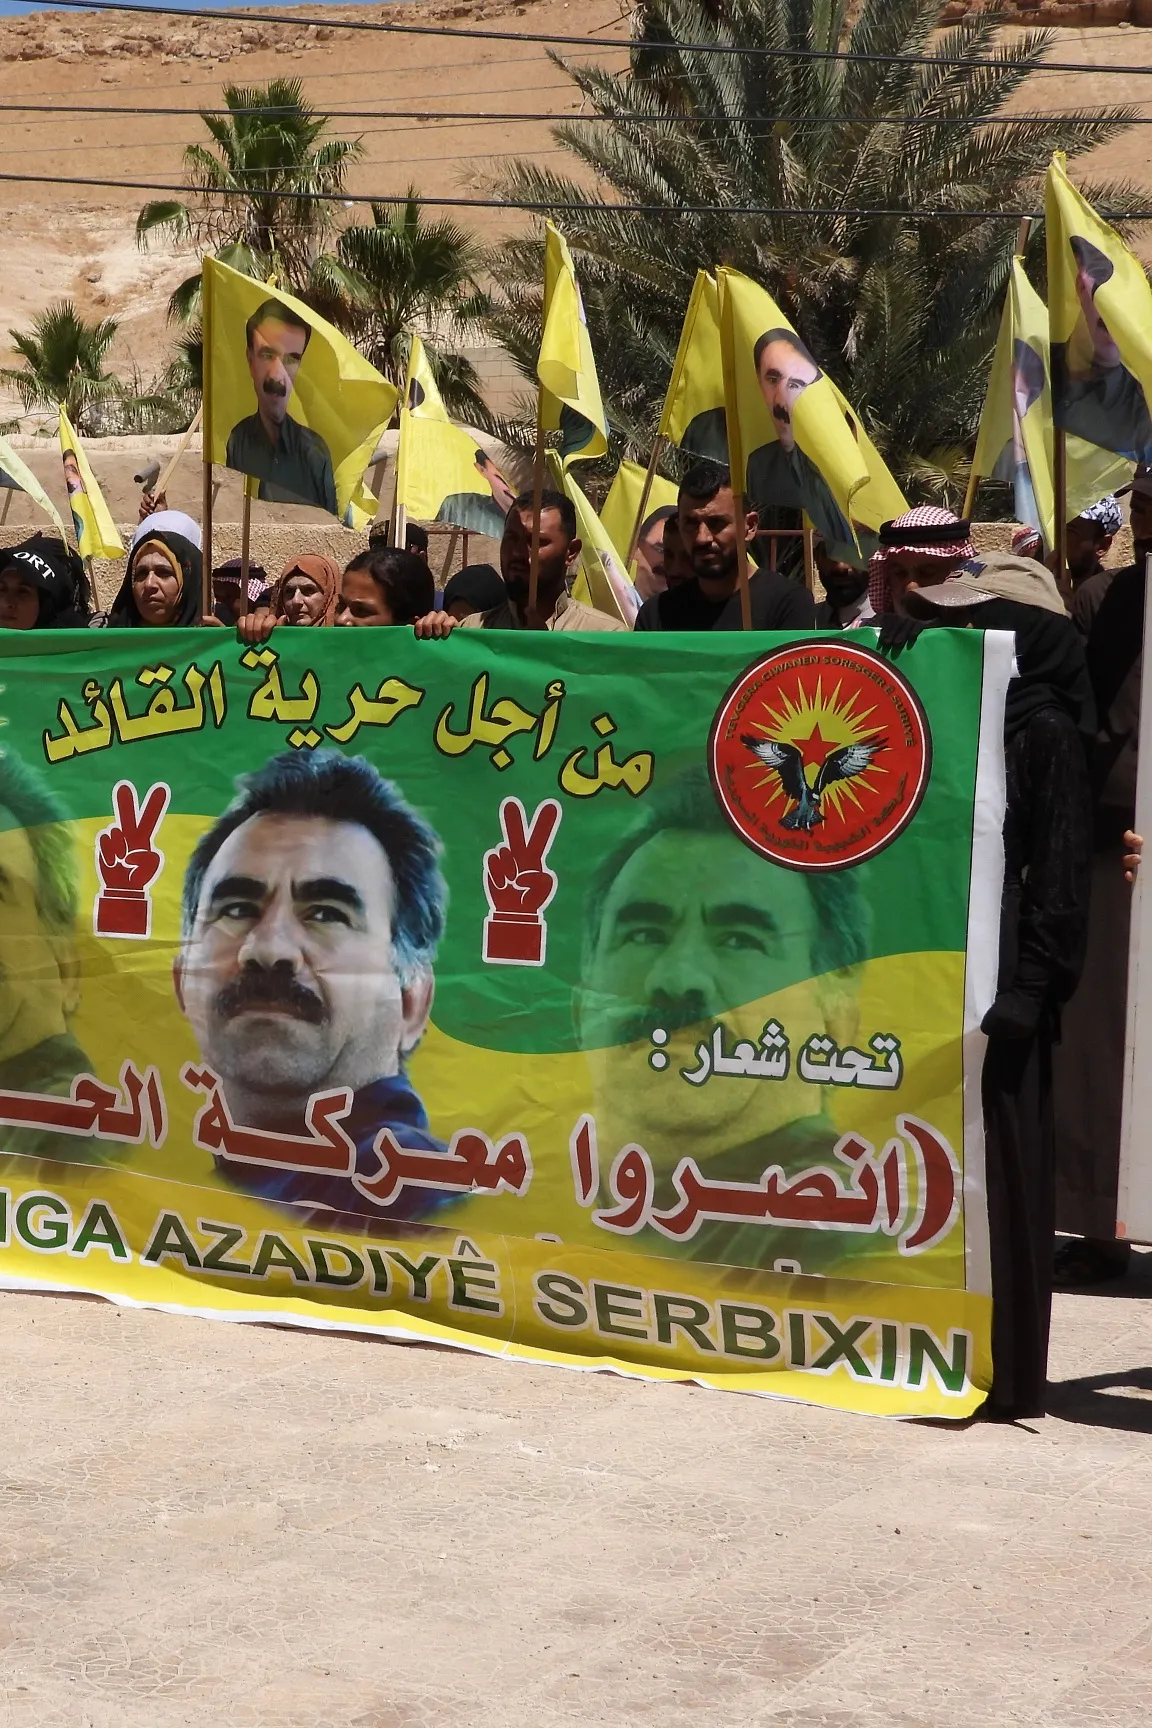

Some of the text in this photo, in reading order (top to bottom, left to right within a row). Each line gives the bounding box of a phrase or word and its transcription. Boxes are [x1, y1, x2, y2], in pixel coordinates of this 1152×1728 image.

[44, 647, 656, 798] من أجل حرية القائد
[725, 680, 763, 740] TEVGERA
[682, 1018, 791, 1087] شعار
[798, 1032, 902, 1090] تحت
[145, 1212, 502, 1314] AZADIYÊ
[535, 1271, 969, 1393] SERBIXIN
